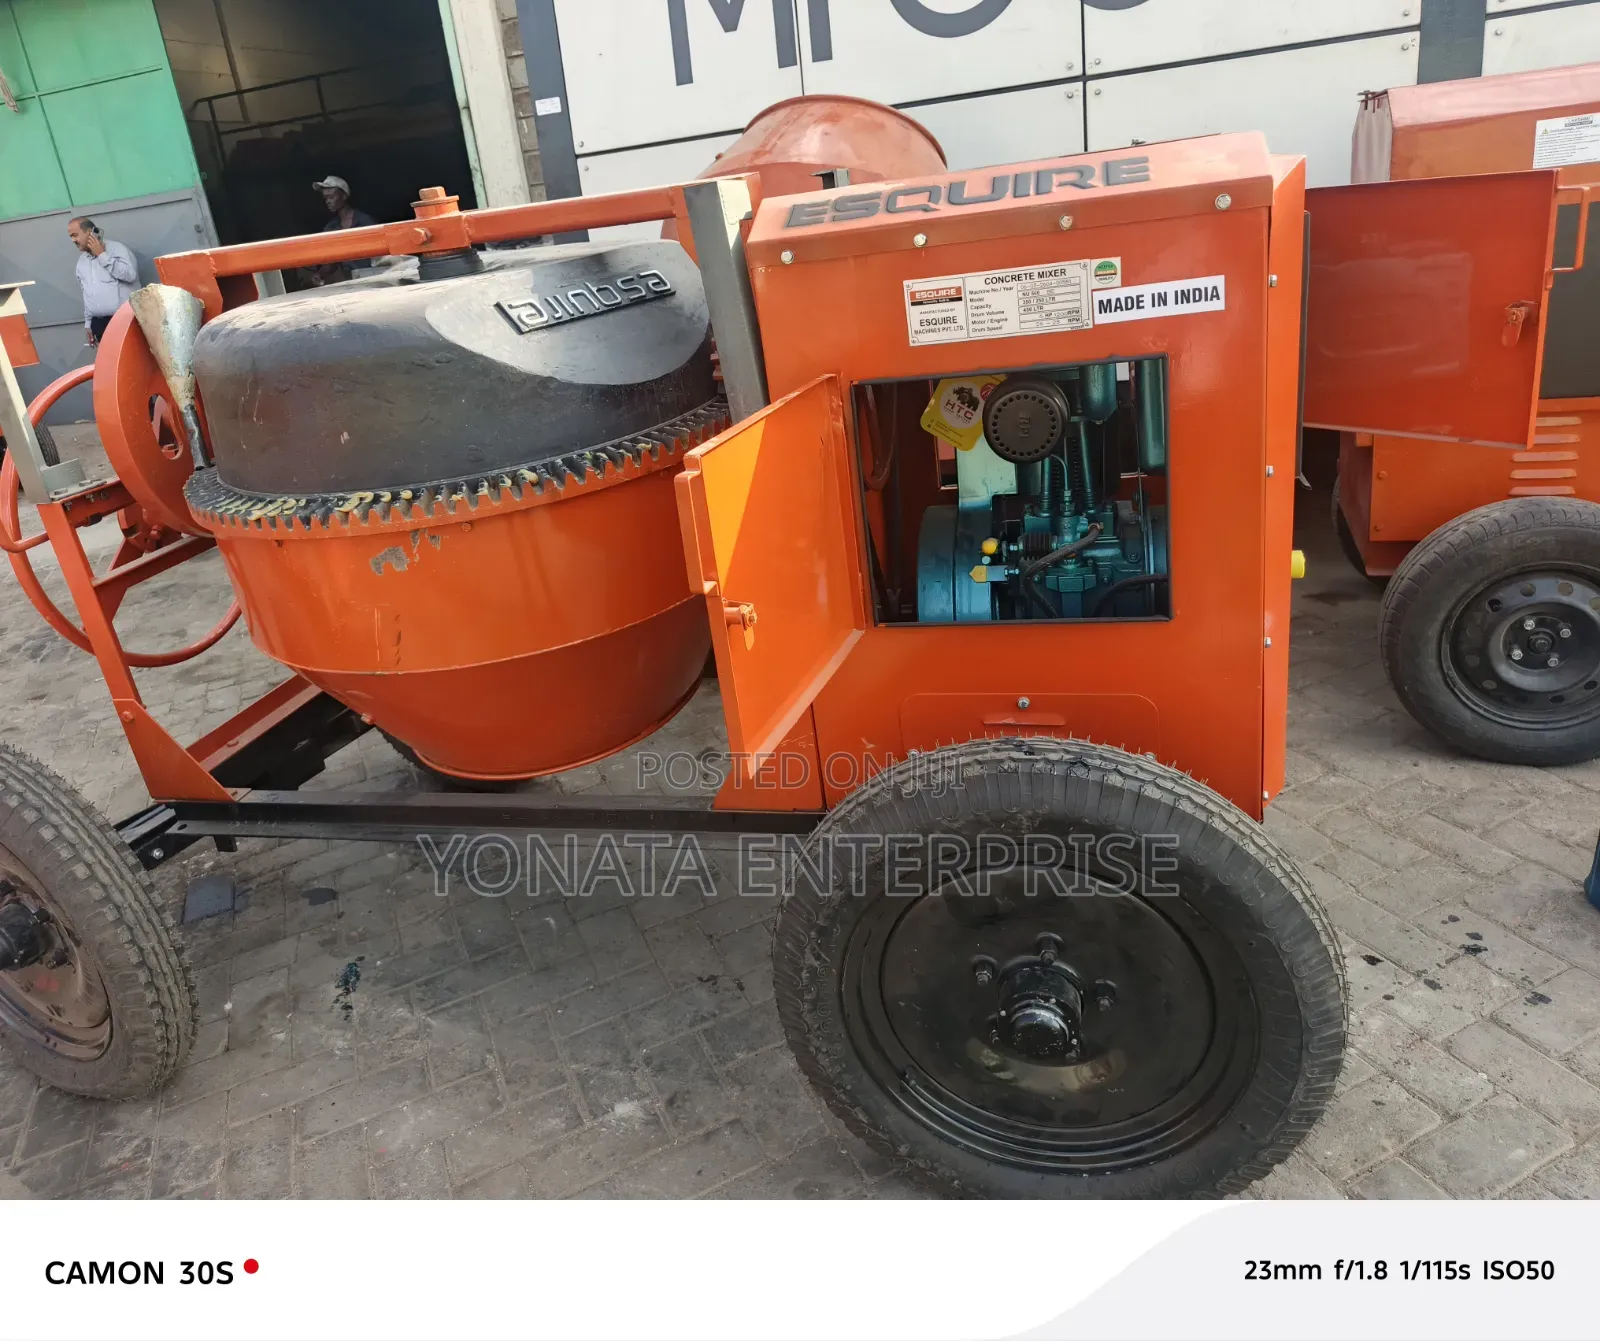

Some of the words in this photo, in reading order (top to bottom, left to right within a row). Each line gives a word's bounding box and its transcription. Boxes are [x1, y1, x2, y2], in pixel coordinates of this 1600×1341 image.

[784, 156, 1151, 228] ESQUIRE
[984, 272, 1035, 285] CONCRETE
[1038, 268, 1067, 278] MIXER
[915, 288, 957, 299] ESQUIRE
[1098, 294, 1145, 315] MADE
[1151, 291, 1168, 308] IN
[1174, 285, 1221, 306] INDIA
[919, 315, 958, 327] ESQUIRE
[914, 327, 941, 335] MACHINES
[945, 398, 974, 421] HTC
